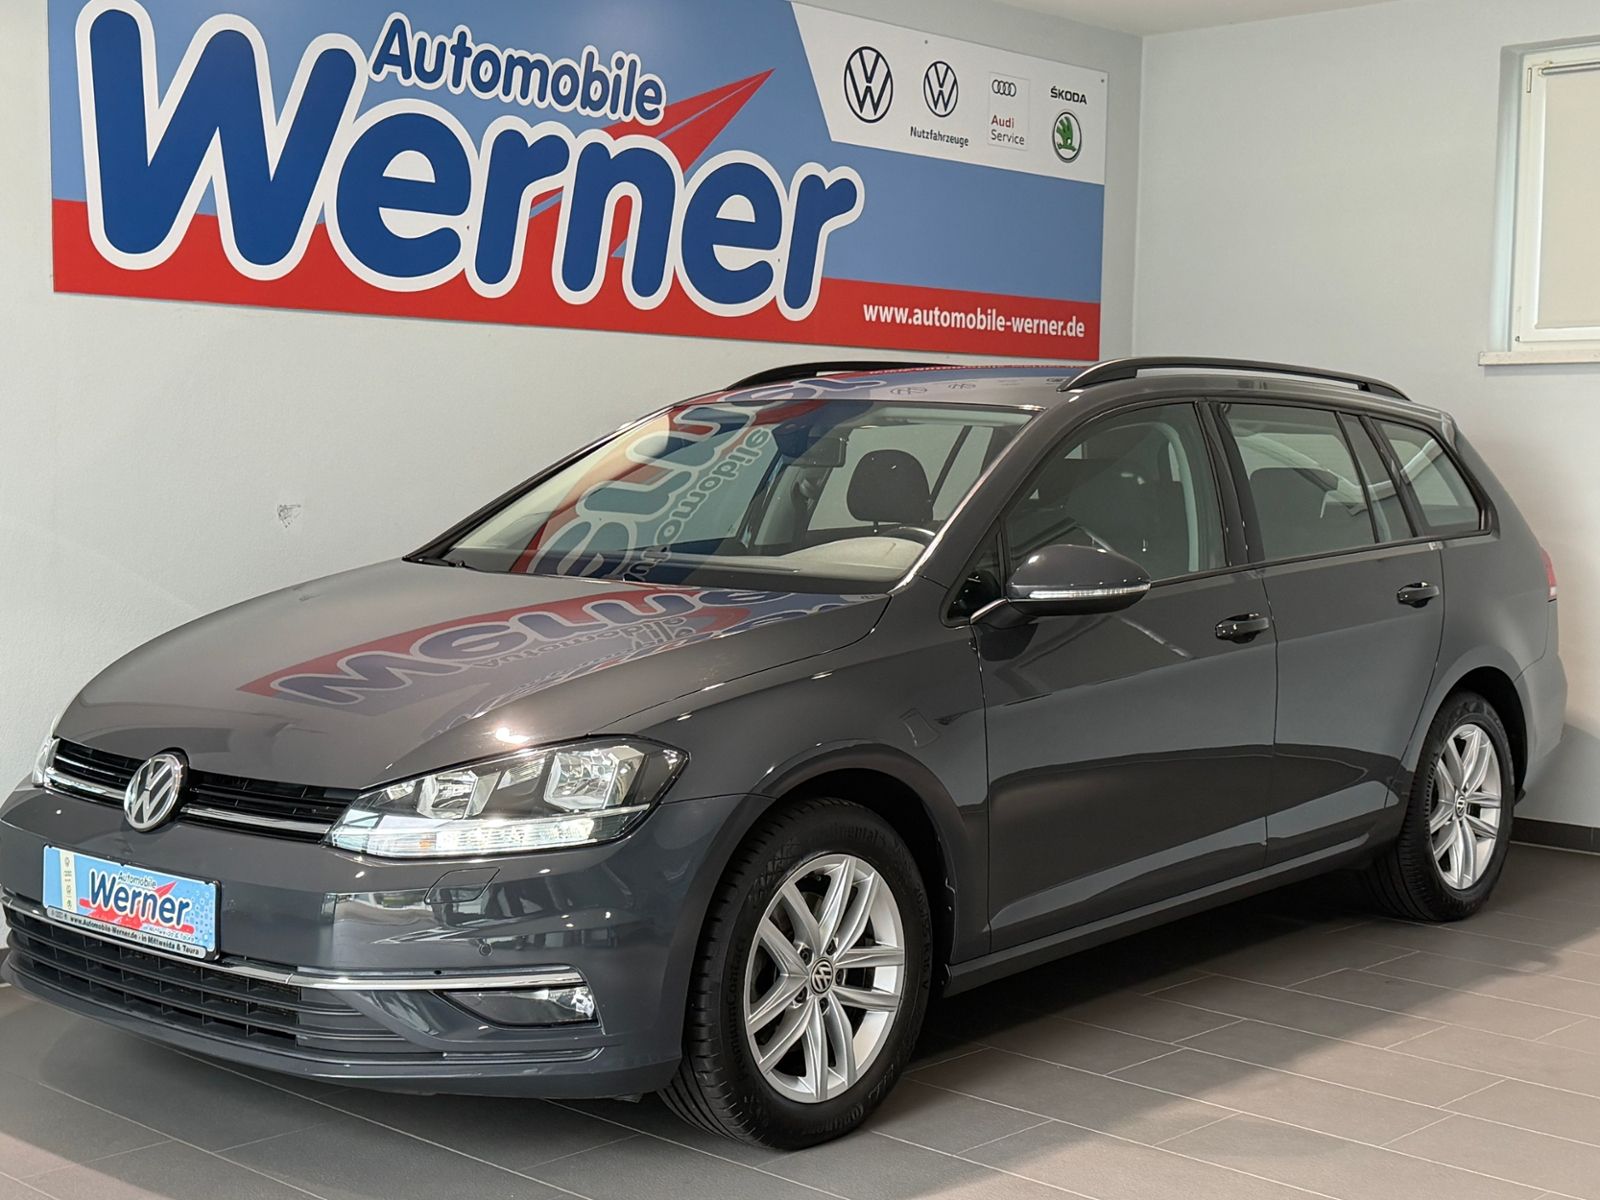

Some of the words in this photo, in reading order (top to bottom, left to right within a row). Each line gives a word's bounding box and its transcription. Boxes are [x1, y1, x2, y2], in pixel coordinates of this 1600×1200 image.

[372, 16, 665, 123] Automobile
[991, 115, 1015, 129] Audi
[910, 126, 969, 147] Nutzfahrzeuge
[990, 130, 1025, 145] Service
[80, 3, 862, 318] Werner
[863, 304, 1085, 338] www.automobile-werner.de
[118, 872, 157, 889] Automobile
[90, 870, 191, 927] Werner
